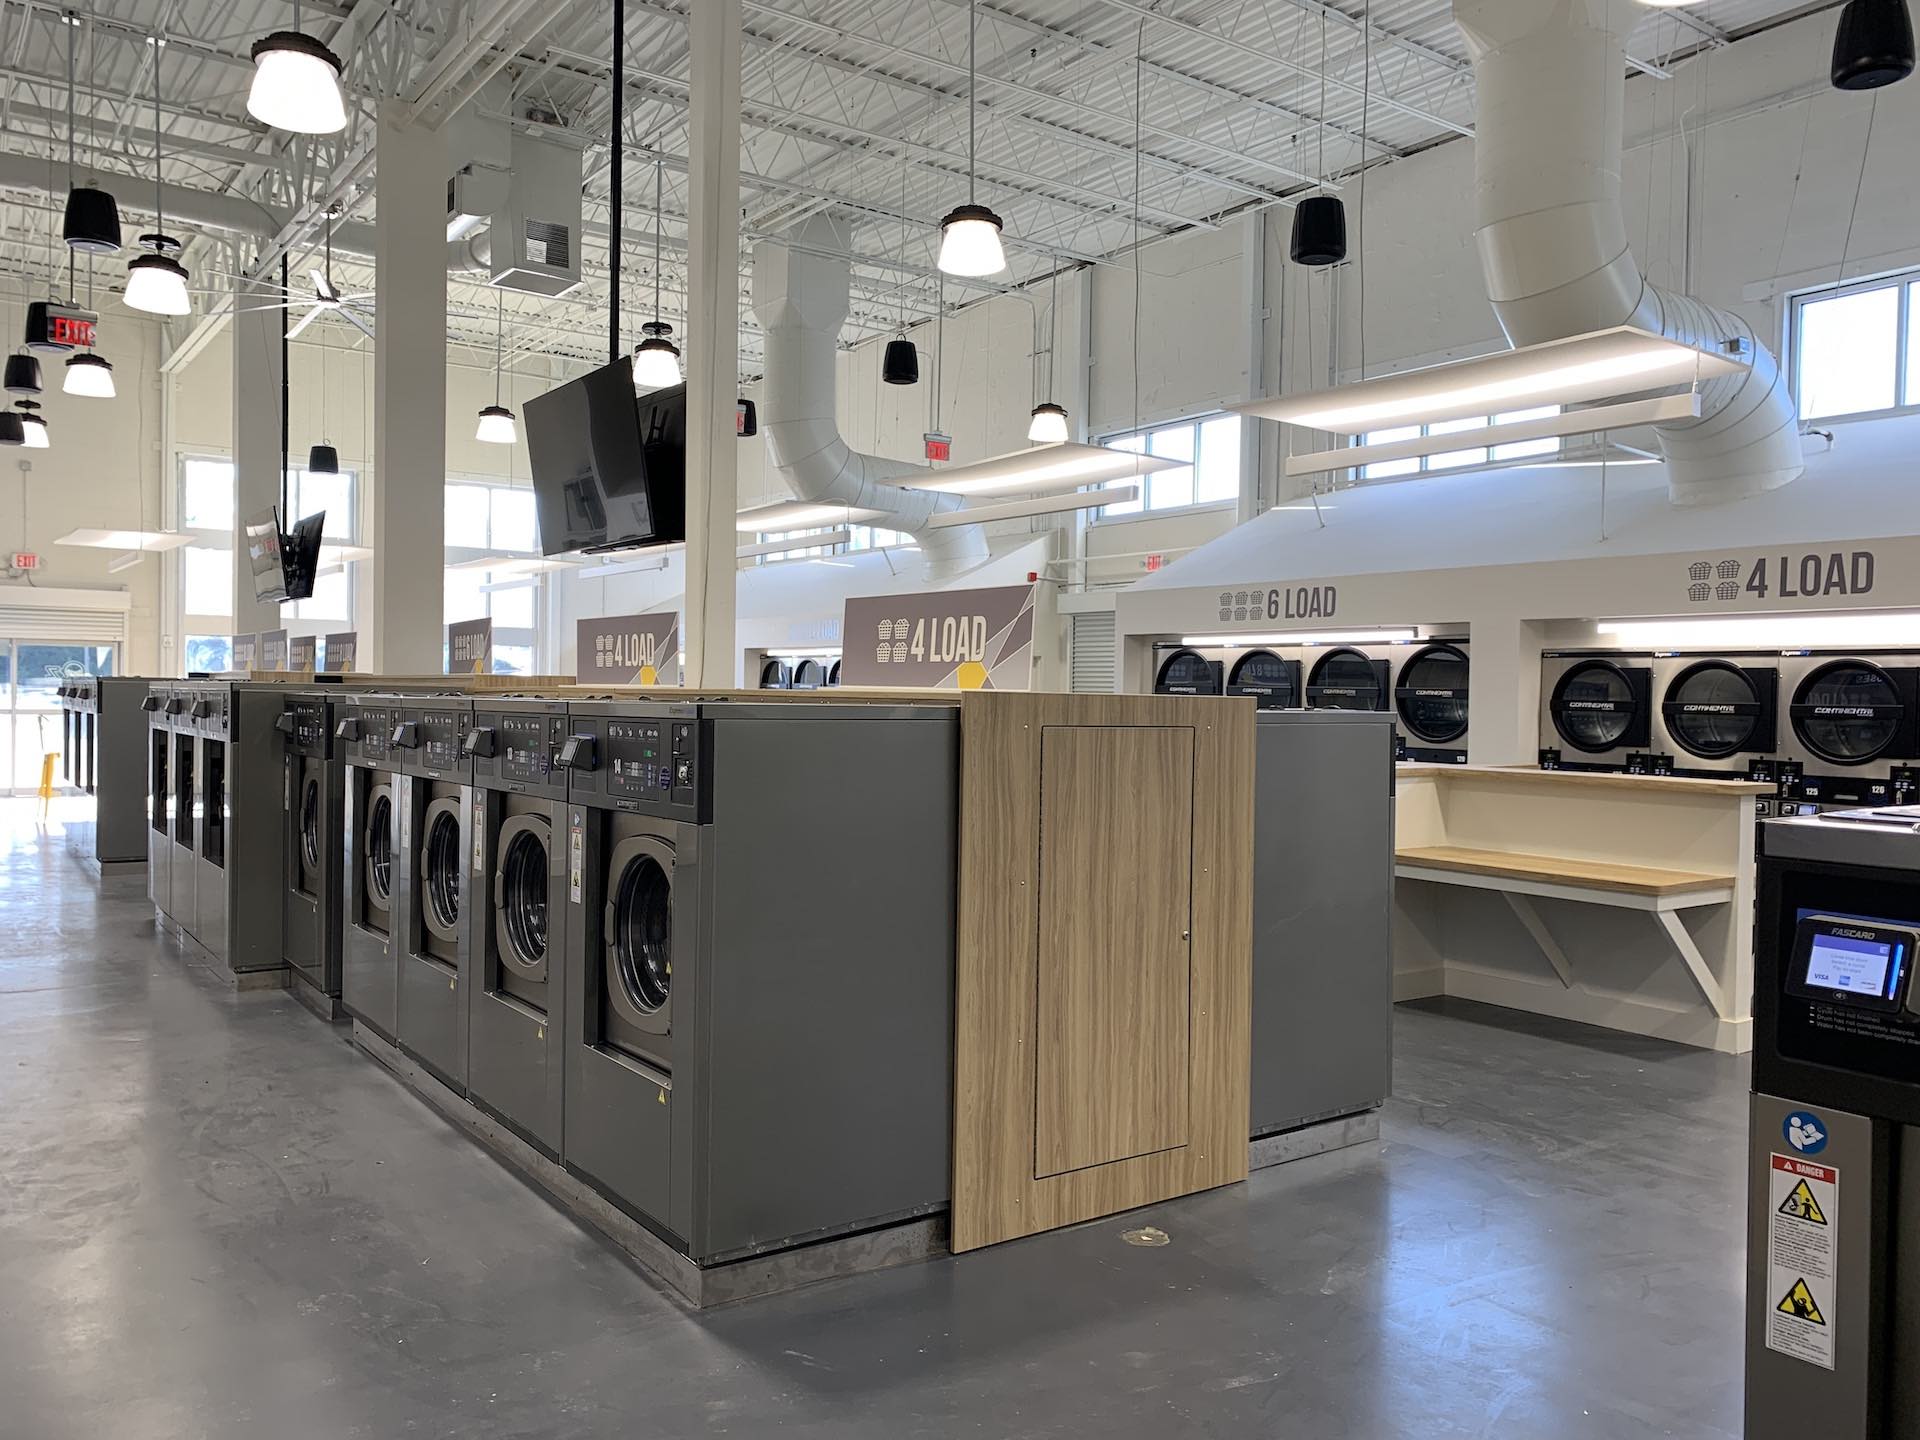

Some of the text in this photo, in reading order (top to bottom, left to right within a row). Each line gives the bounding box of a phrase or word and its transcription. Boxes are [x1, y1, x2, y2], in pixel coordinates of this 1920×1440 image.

[16, 553, 37, 568] EXIT
[1745, 551, 1874, 598] 4 LOAD
[1267, 586, 1337, 619] 6 LOAD
[614, 632, 655, 667] 4 LOAD
[910, 615, 987, 662] 4 LOAD
[1832, 928, 1875, 940] FASCARD
[1796, 1163, 1825, 1179] DANGER
